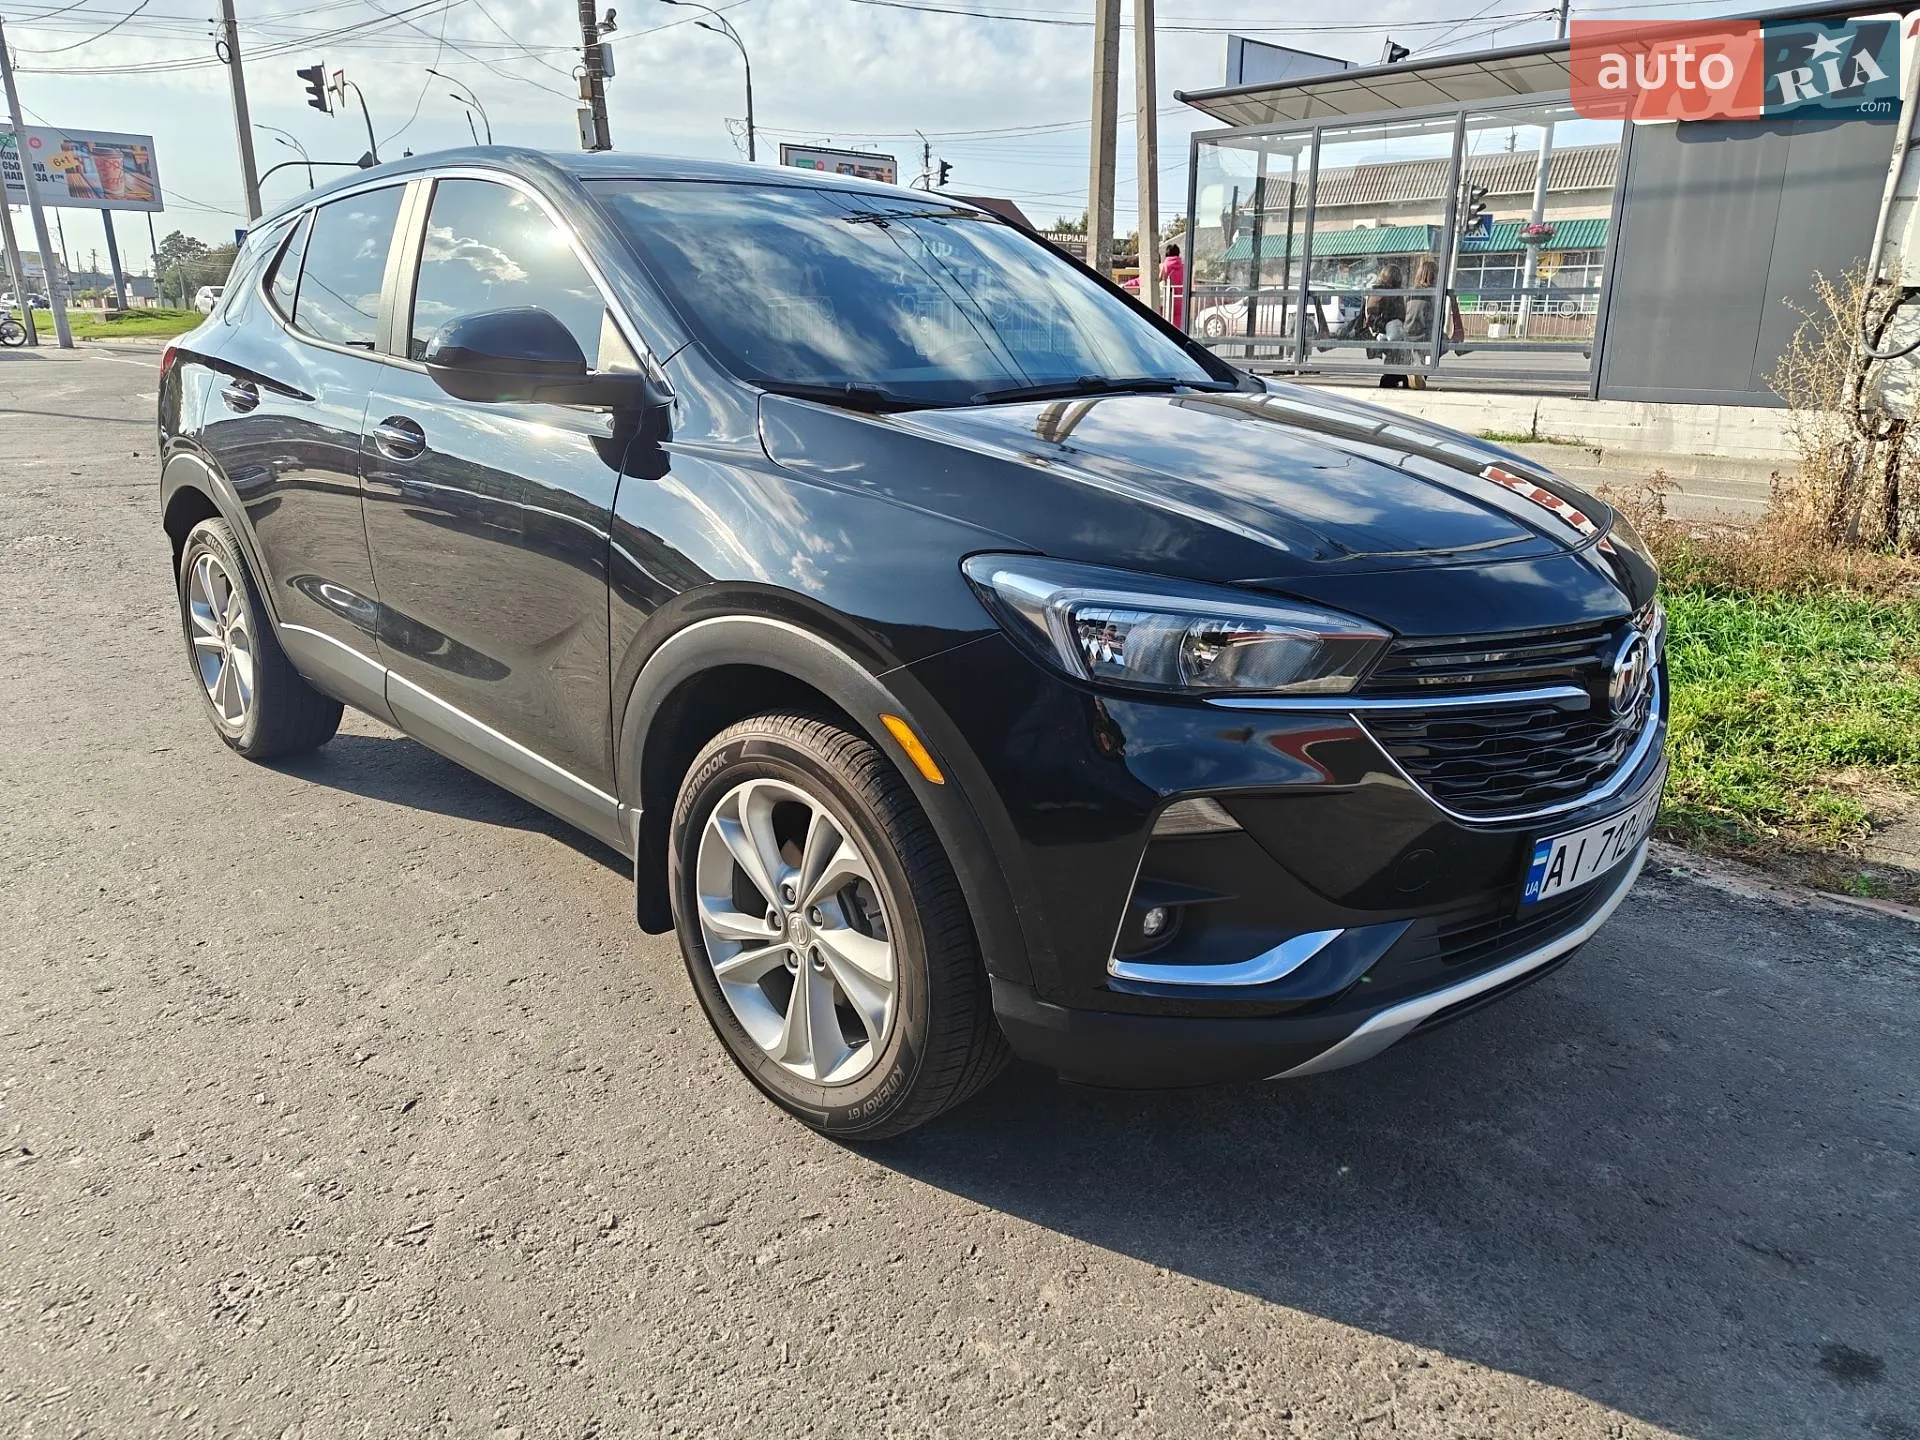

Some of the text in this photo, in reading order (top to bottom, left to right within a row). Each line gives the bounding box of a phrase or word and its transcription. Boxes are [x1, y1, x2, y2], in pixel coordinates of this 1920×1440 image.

[53, 156, 72, 167] 6+1
[36, 173, 48, 182] ЗА
[1542, 839, 1587, 893] AI
[1525, 881, 1539, 896] UA
[848, 1107, 860, 1120] GT
